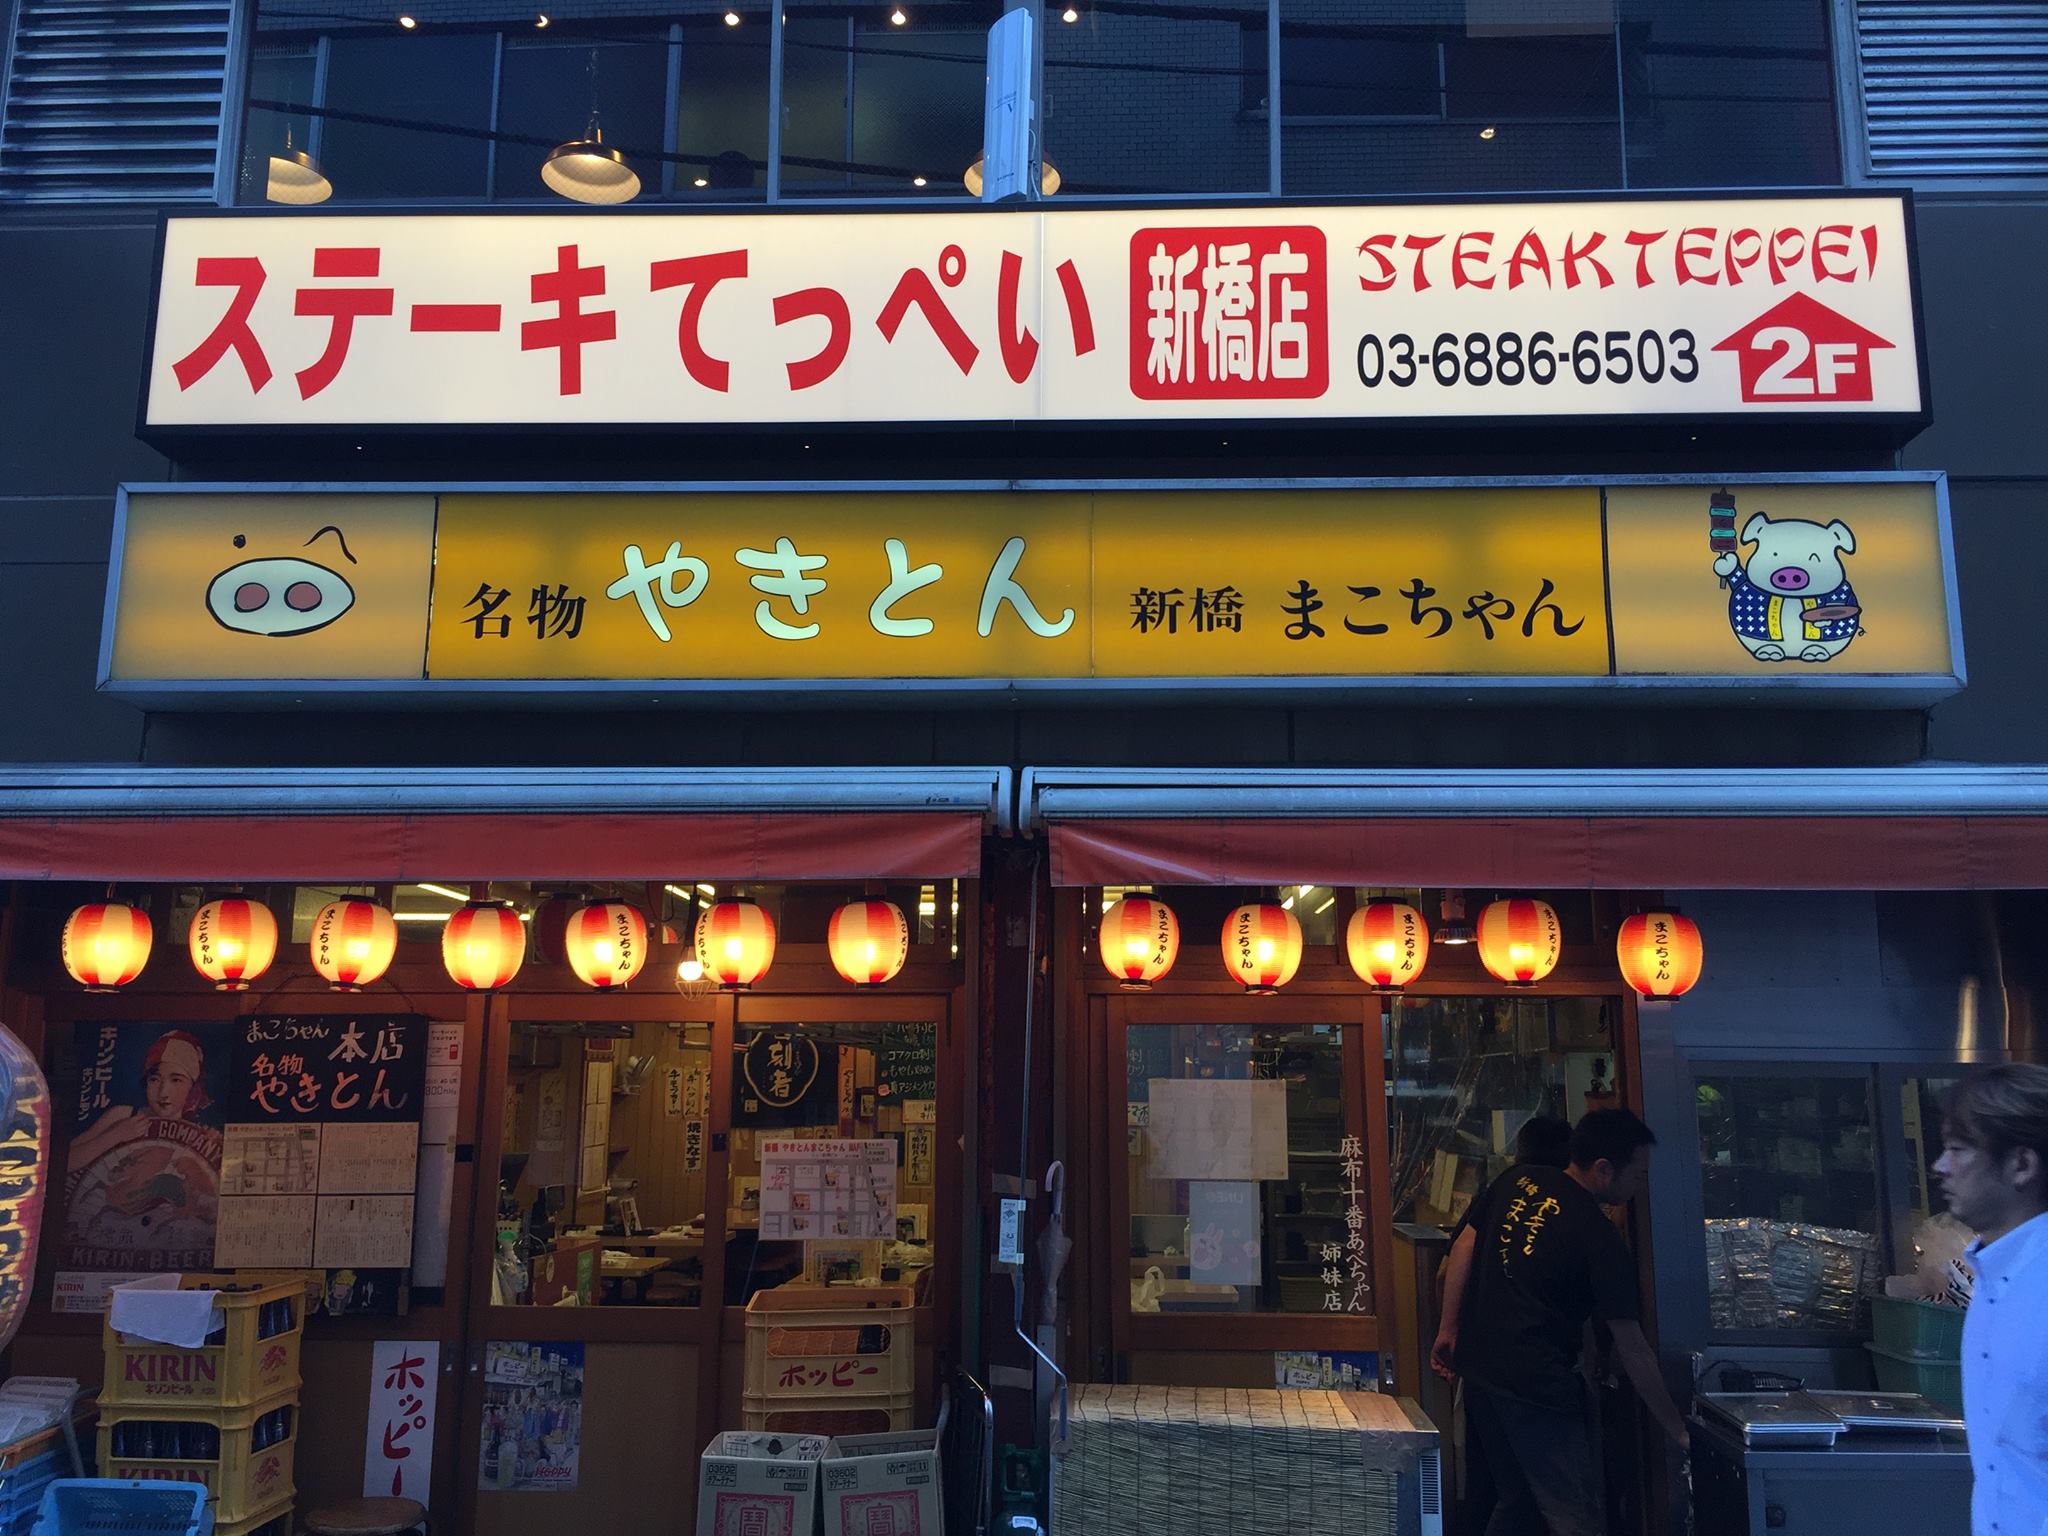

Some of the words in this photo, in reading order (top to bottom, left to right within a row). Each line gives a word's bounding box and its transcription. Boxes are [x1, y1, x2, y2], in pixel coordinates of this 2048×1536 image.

[1355, 226, 1615, 292] STEAK
[1625, 224, 1879, 288] TEPPEI
[171, 244, 1096, 400] ステーキてっぺい
[1147, 240, 1309, 384] 新橋店
[1357, 328, 1700, 388] 03-6886-6503
[1752, 326, 1859, 396] 2F
[461, 582, 585, 641] 名物
[606, 537, 1075, 642] やきとん
[1130, 586, 1243, 637] 新橋
[1280, 578, 1586, 641] まこちゃん
[198, 908, 213, 965] まこちゃん
[319, 908, 336, 965] まこちゃん
[616, 912, 631, 971] まこちゃん
[1153, 908, 1169, 965] まこちゃん
[1238, 912, 1253, 969] まこちゃん
[1400, 913, 1415, 971] まこちゃん
[1543, 908, 1558, 966] まこちゃん
[1653, 920, 1670, 980] まこちゃん
[95, 1026, 118, 1110] キリンビール
[246, 1018, 330, 1044] まこちゃん
[327, 1021, 407, 1065] 本店
[250, 1052, 304, 1077] 名物
[249, 1067, 409, 1114] やきとん
[1339, 1134, 1371, 1312] 麻布十番あべちゃん
[56, 1282, 85, 1292] KIRIN
[1320, 1243, 1344, 1312] 姉妹店
[125, 1354, 217, 1382] KIRIN
[145, 1384, 194, 1395] キリンビール
[779, 1361, 879, 1388] ホッピー
[380, 1345, 427, 1497] ホッピー
